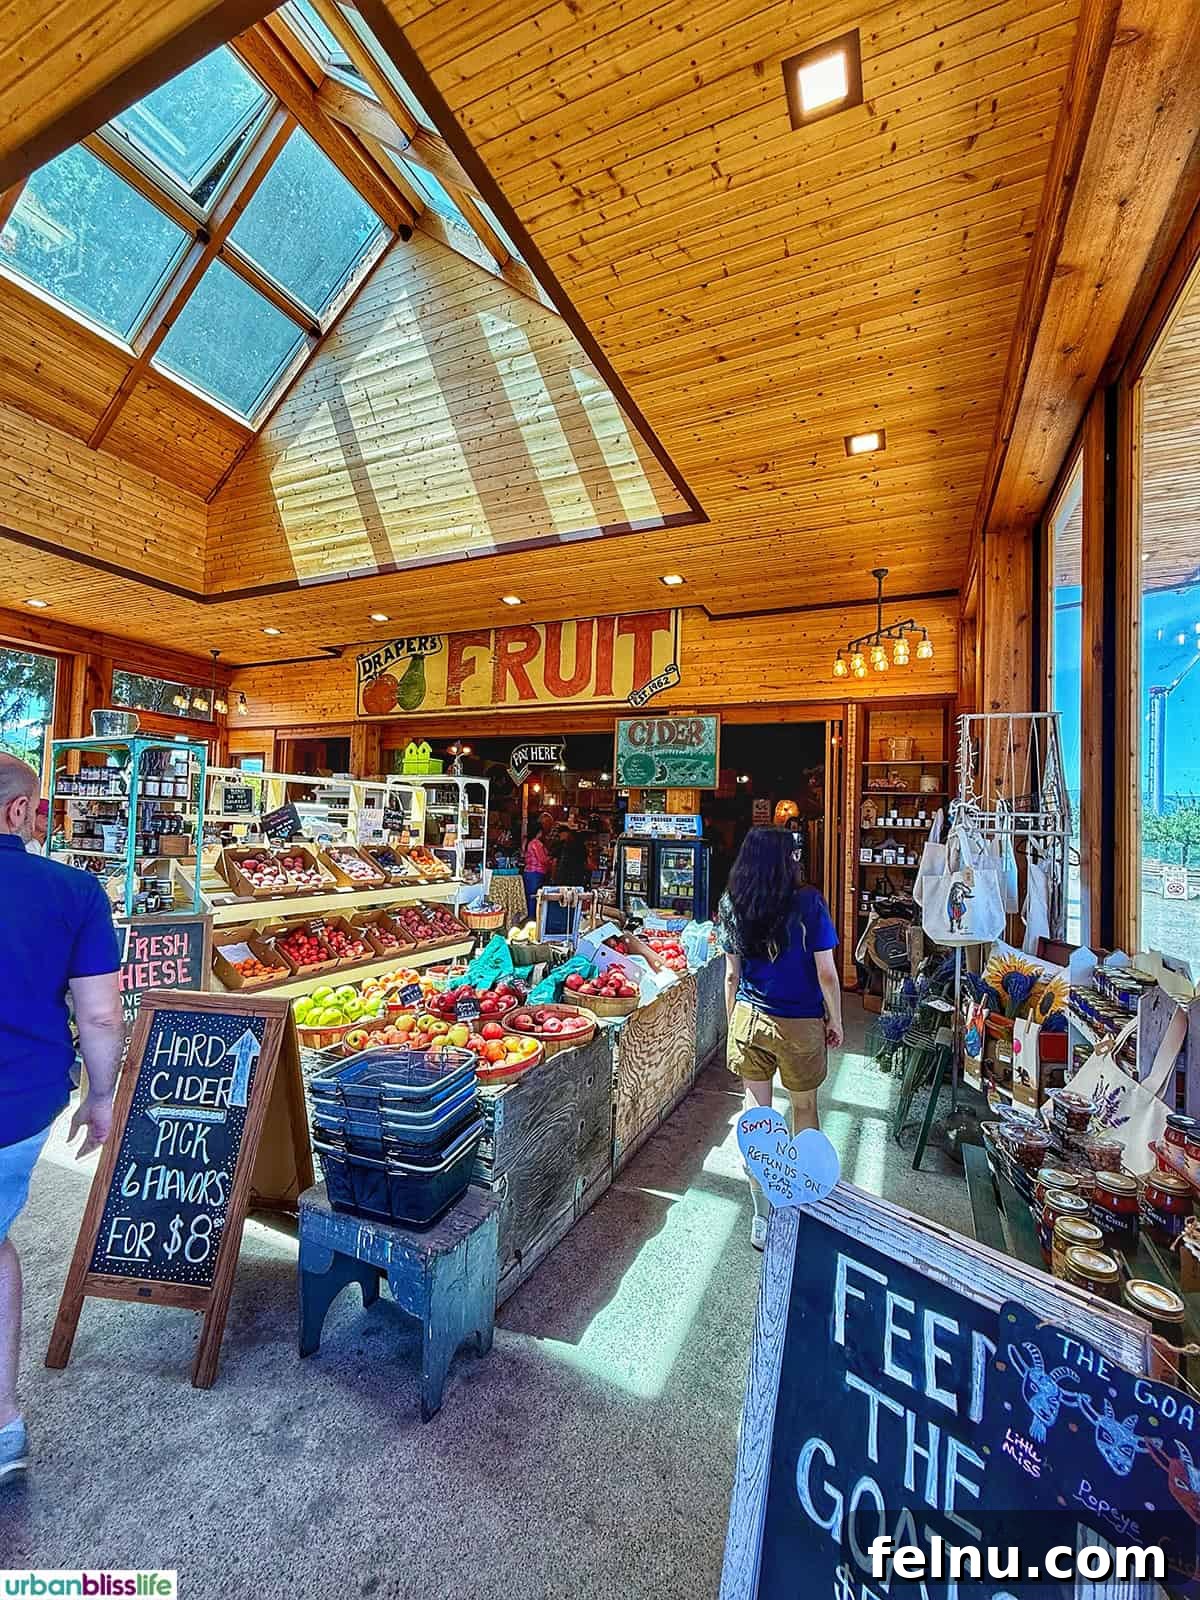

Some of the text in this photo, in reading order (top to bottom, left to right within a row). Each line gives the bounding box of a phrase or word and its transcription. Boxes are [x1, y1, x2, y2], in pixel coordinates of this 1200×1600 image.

[446, 609, 671, 706] FRUIT
[648, 676, 670, 693] 1962
[628, 719, 705, 746] CIDER
[530, 746, 558, 761] HERE
[119, 958, 192, 992] HEESE
[152, 1032, 226, 1068] HARD
[151, 1072, 233, 1108] CIDER
[154, 1120, 211, 1164] PICK
[741, 1119, 772, 1134] Sorry
[776, 1142, 797, 1160] NO
[121, 1162, 229, 1206] 6 FLAVORS
[768, 1181, 793, 1199] FOOD
[804, 1180, 820, 1194] ON
[106, 1217, 156, 1257] FOR
[1056, 1333, 1200, 1431] THE GOA
[845, 1370, 986, 1542] THE
[1002, 1442, 1041, 1478] Miss
[1005, 1428, 1042, 1463] Little
[1078, 1479, 1140, 1534] Popeye
